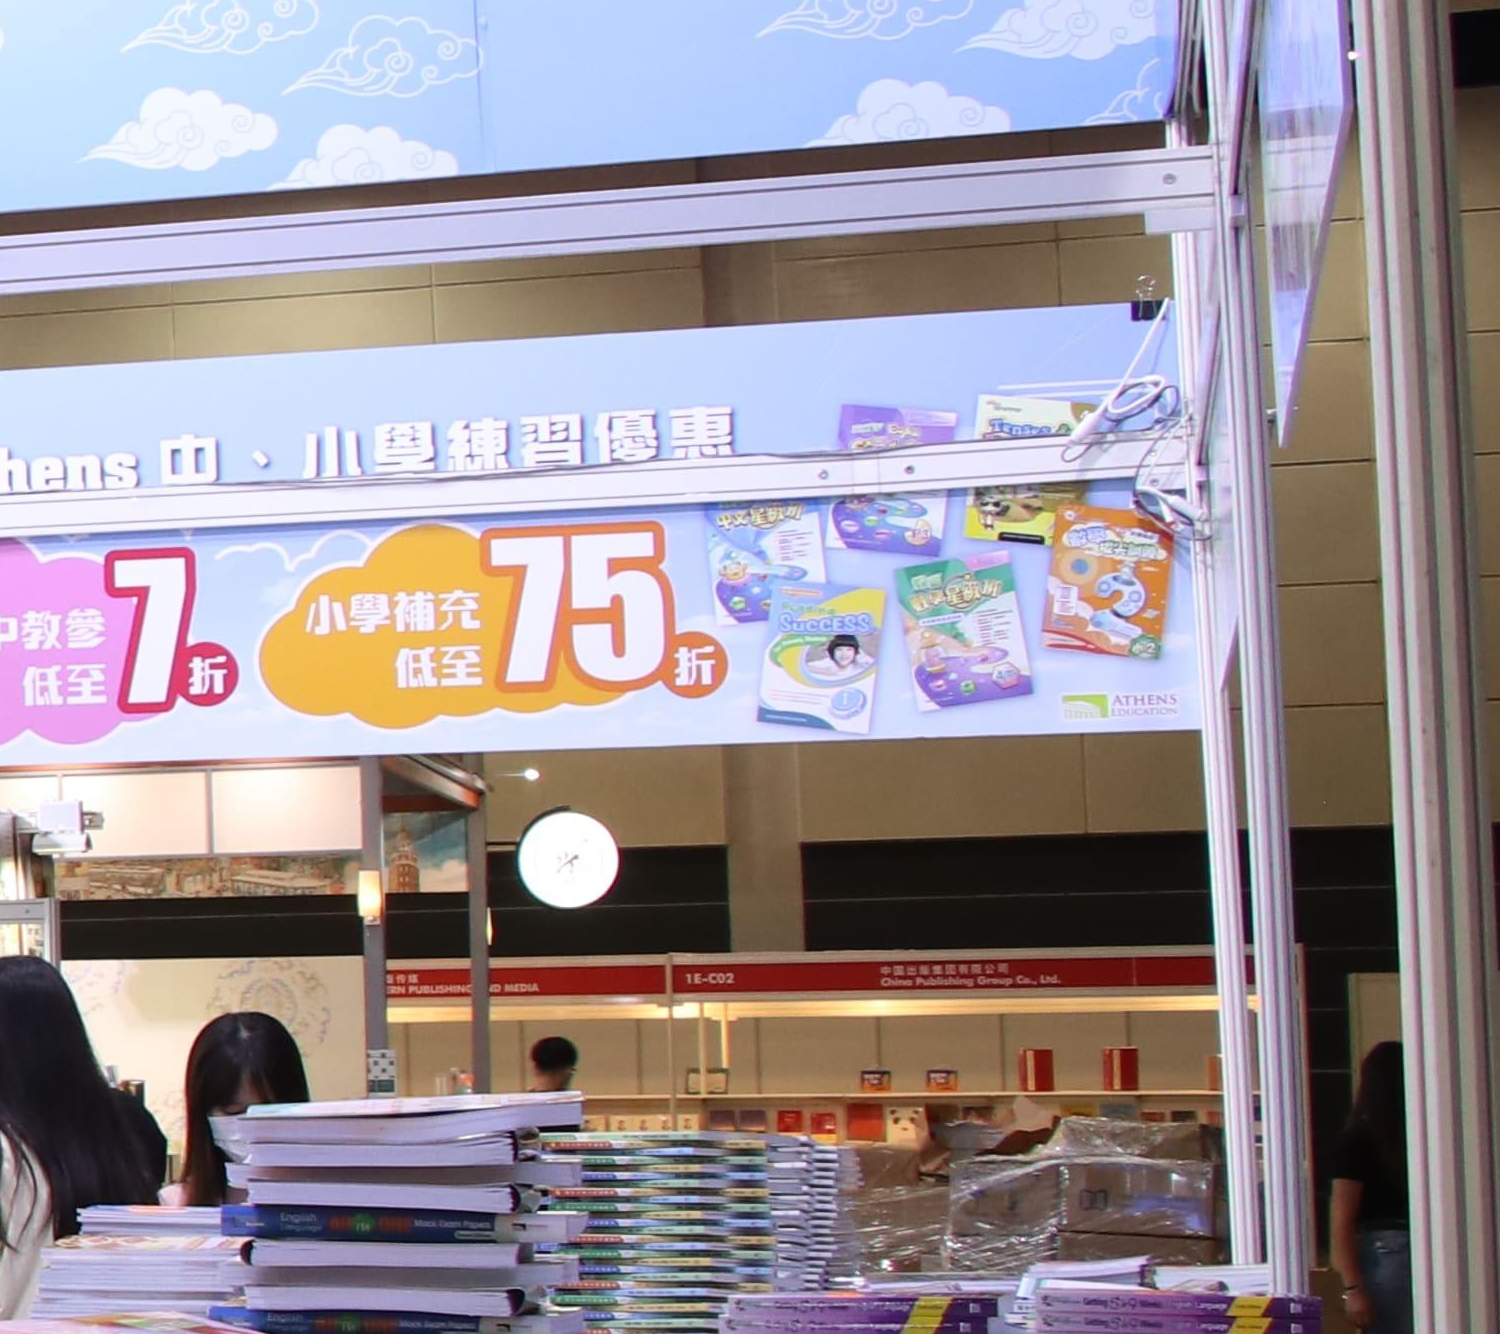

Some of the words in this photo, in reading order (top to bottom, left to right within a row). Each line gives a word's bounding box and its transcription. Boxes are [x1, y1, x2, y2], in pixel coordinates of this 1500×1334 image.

[304, 589, 482, 636] 小學補充
[489, 530, 668, 685] 75
[672, 644, 717, 688] 折
[112, 556, 188, 706] 7
[187, 655, 228, 697] 折
[395, 644, 484, 690] 低至
[22, 662, 108, 708] 低至
[1111, 692, 1178, 708] ATHENS
[1111, 706, 1178, 718] EDUCATION
[684, 972, 736, 985] 1E-C02
[880, 976, 913, 987] China
[915, 976, 974, 988] Publishing
[977, 975, 1013, 987] Group
[503, 982, 540, 993] MEDIA
